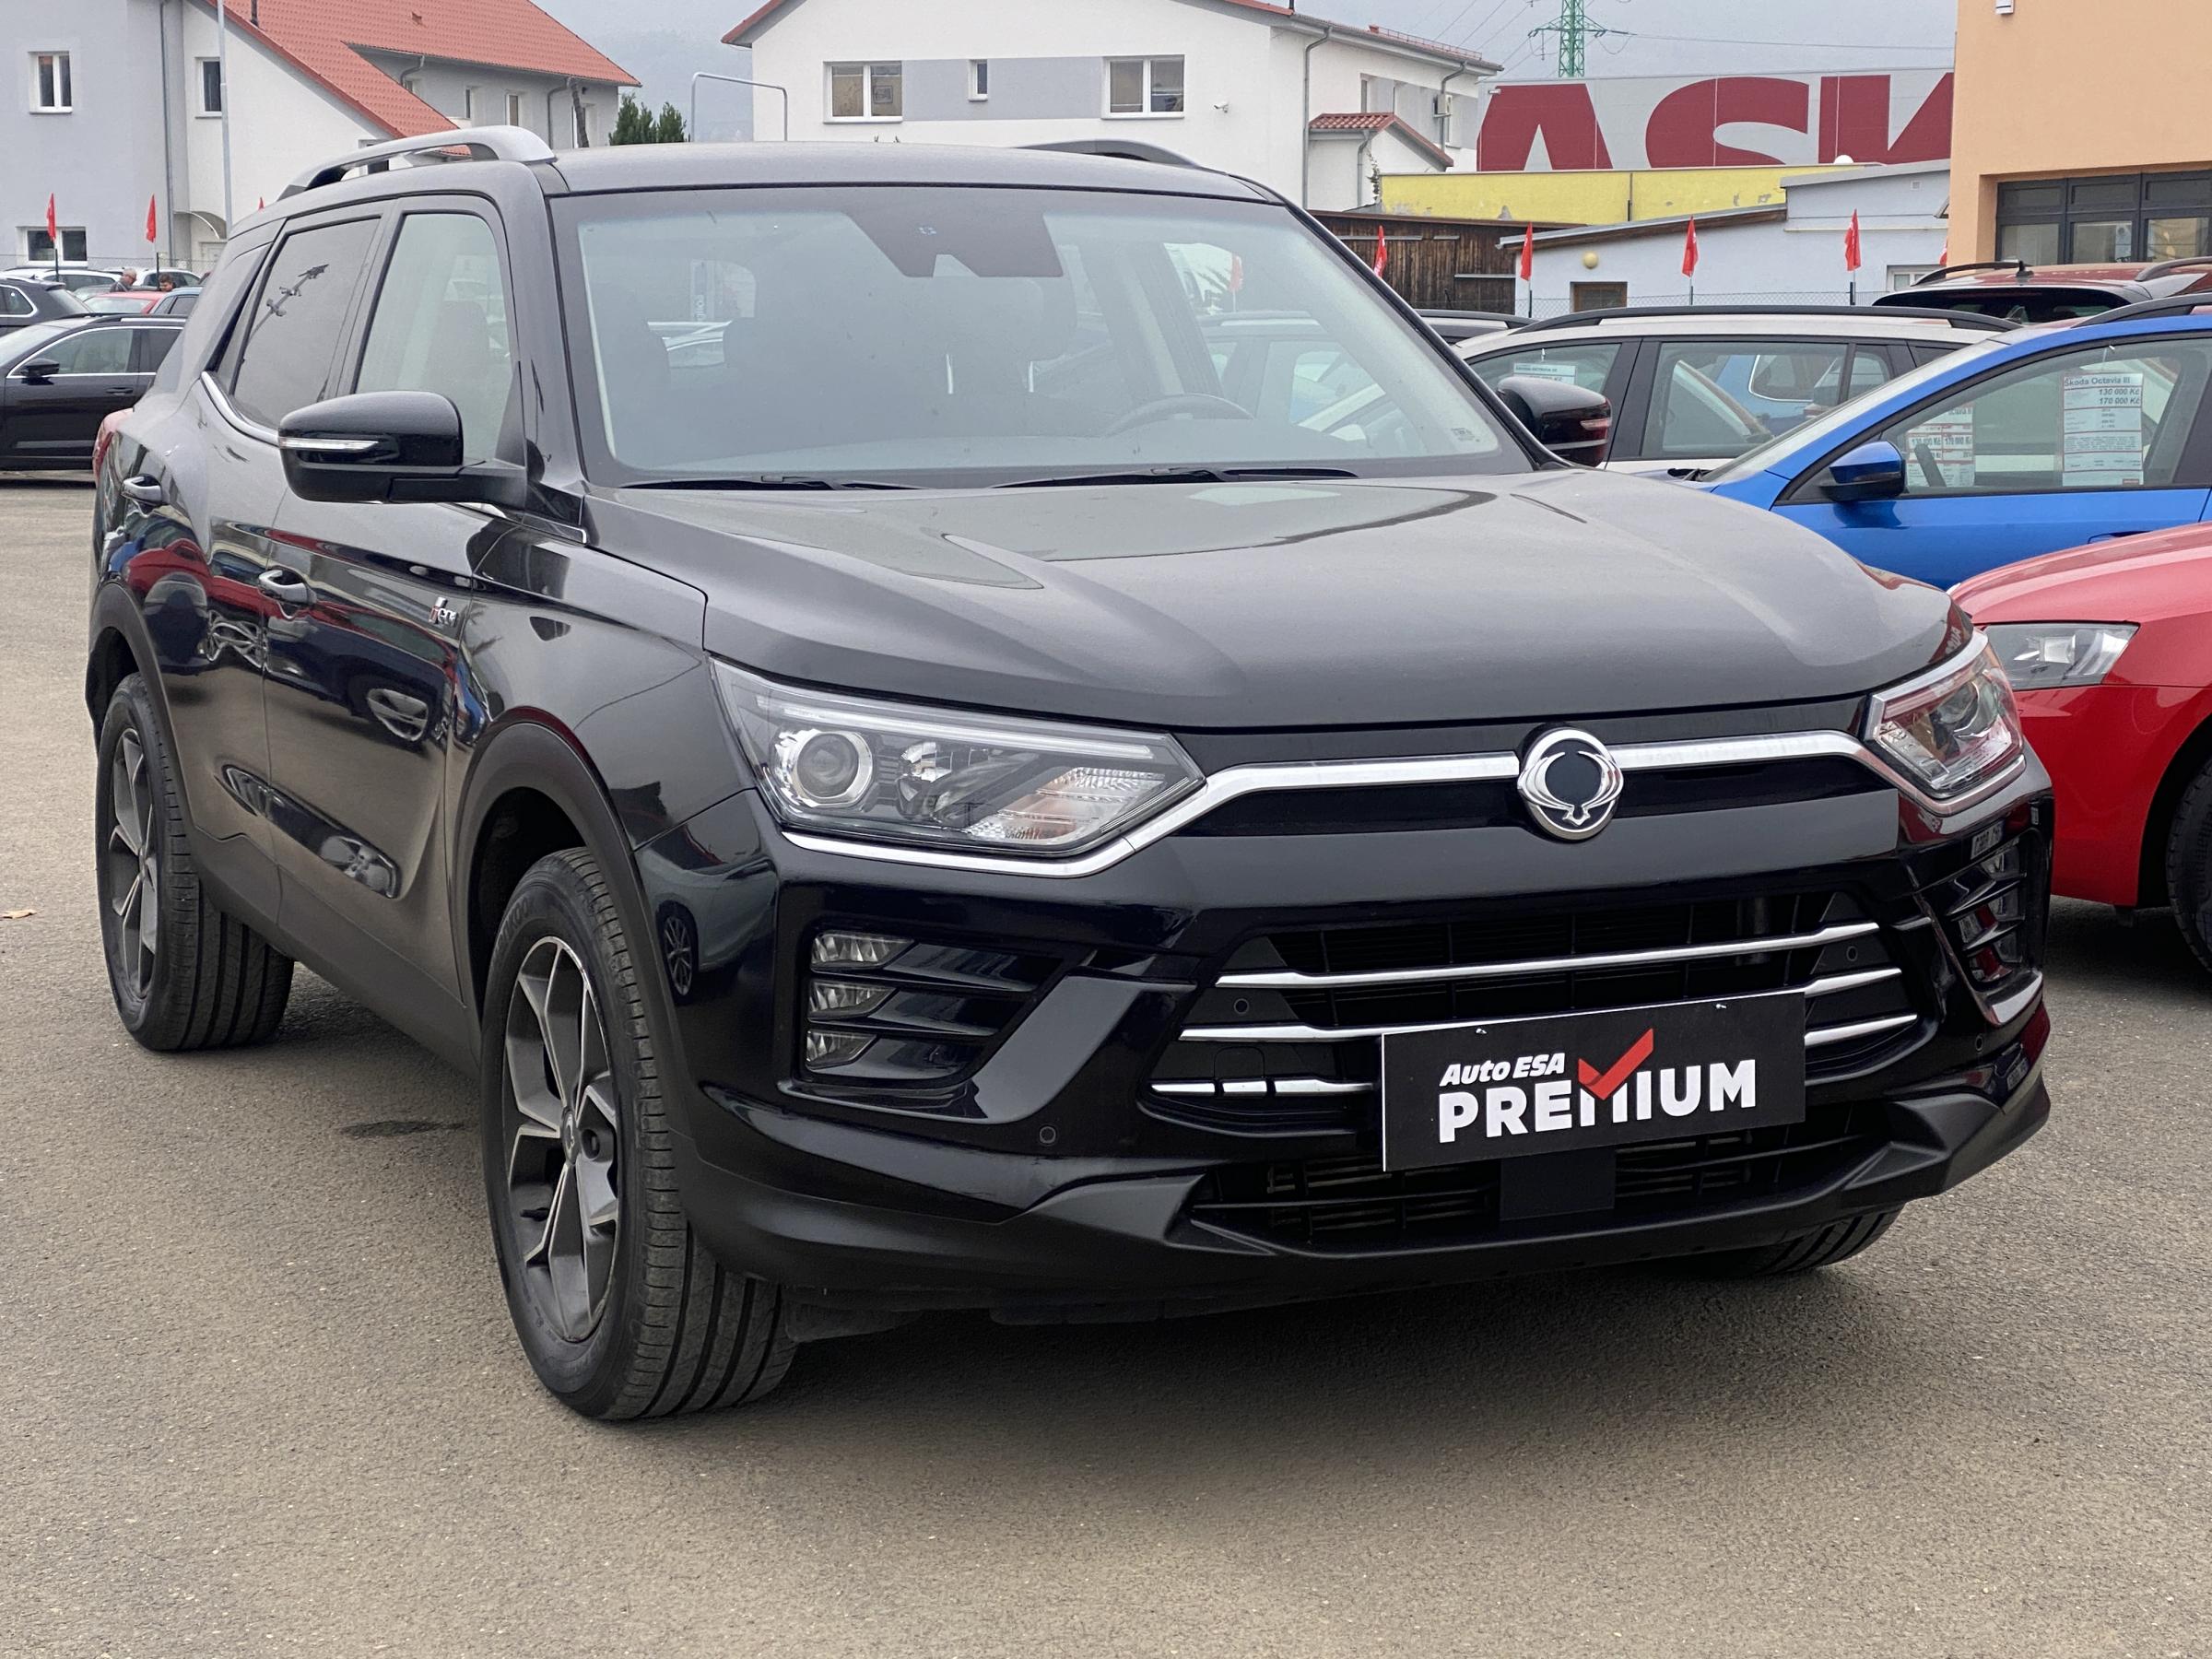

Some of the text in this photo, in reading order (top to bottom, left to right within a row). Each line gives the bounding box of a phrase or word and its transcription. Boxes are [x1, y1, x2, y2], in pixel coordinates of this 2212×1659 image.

[2065, 377, 2089, 386] Škoda
[2130, 387, 2140, 395] Kč
[2130, 396, 2140, 405] Kč
[1439, 1053, 1565, 1087] Auto ESA
[1439, 1059, 1757, 1144] PREMIUM
